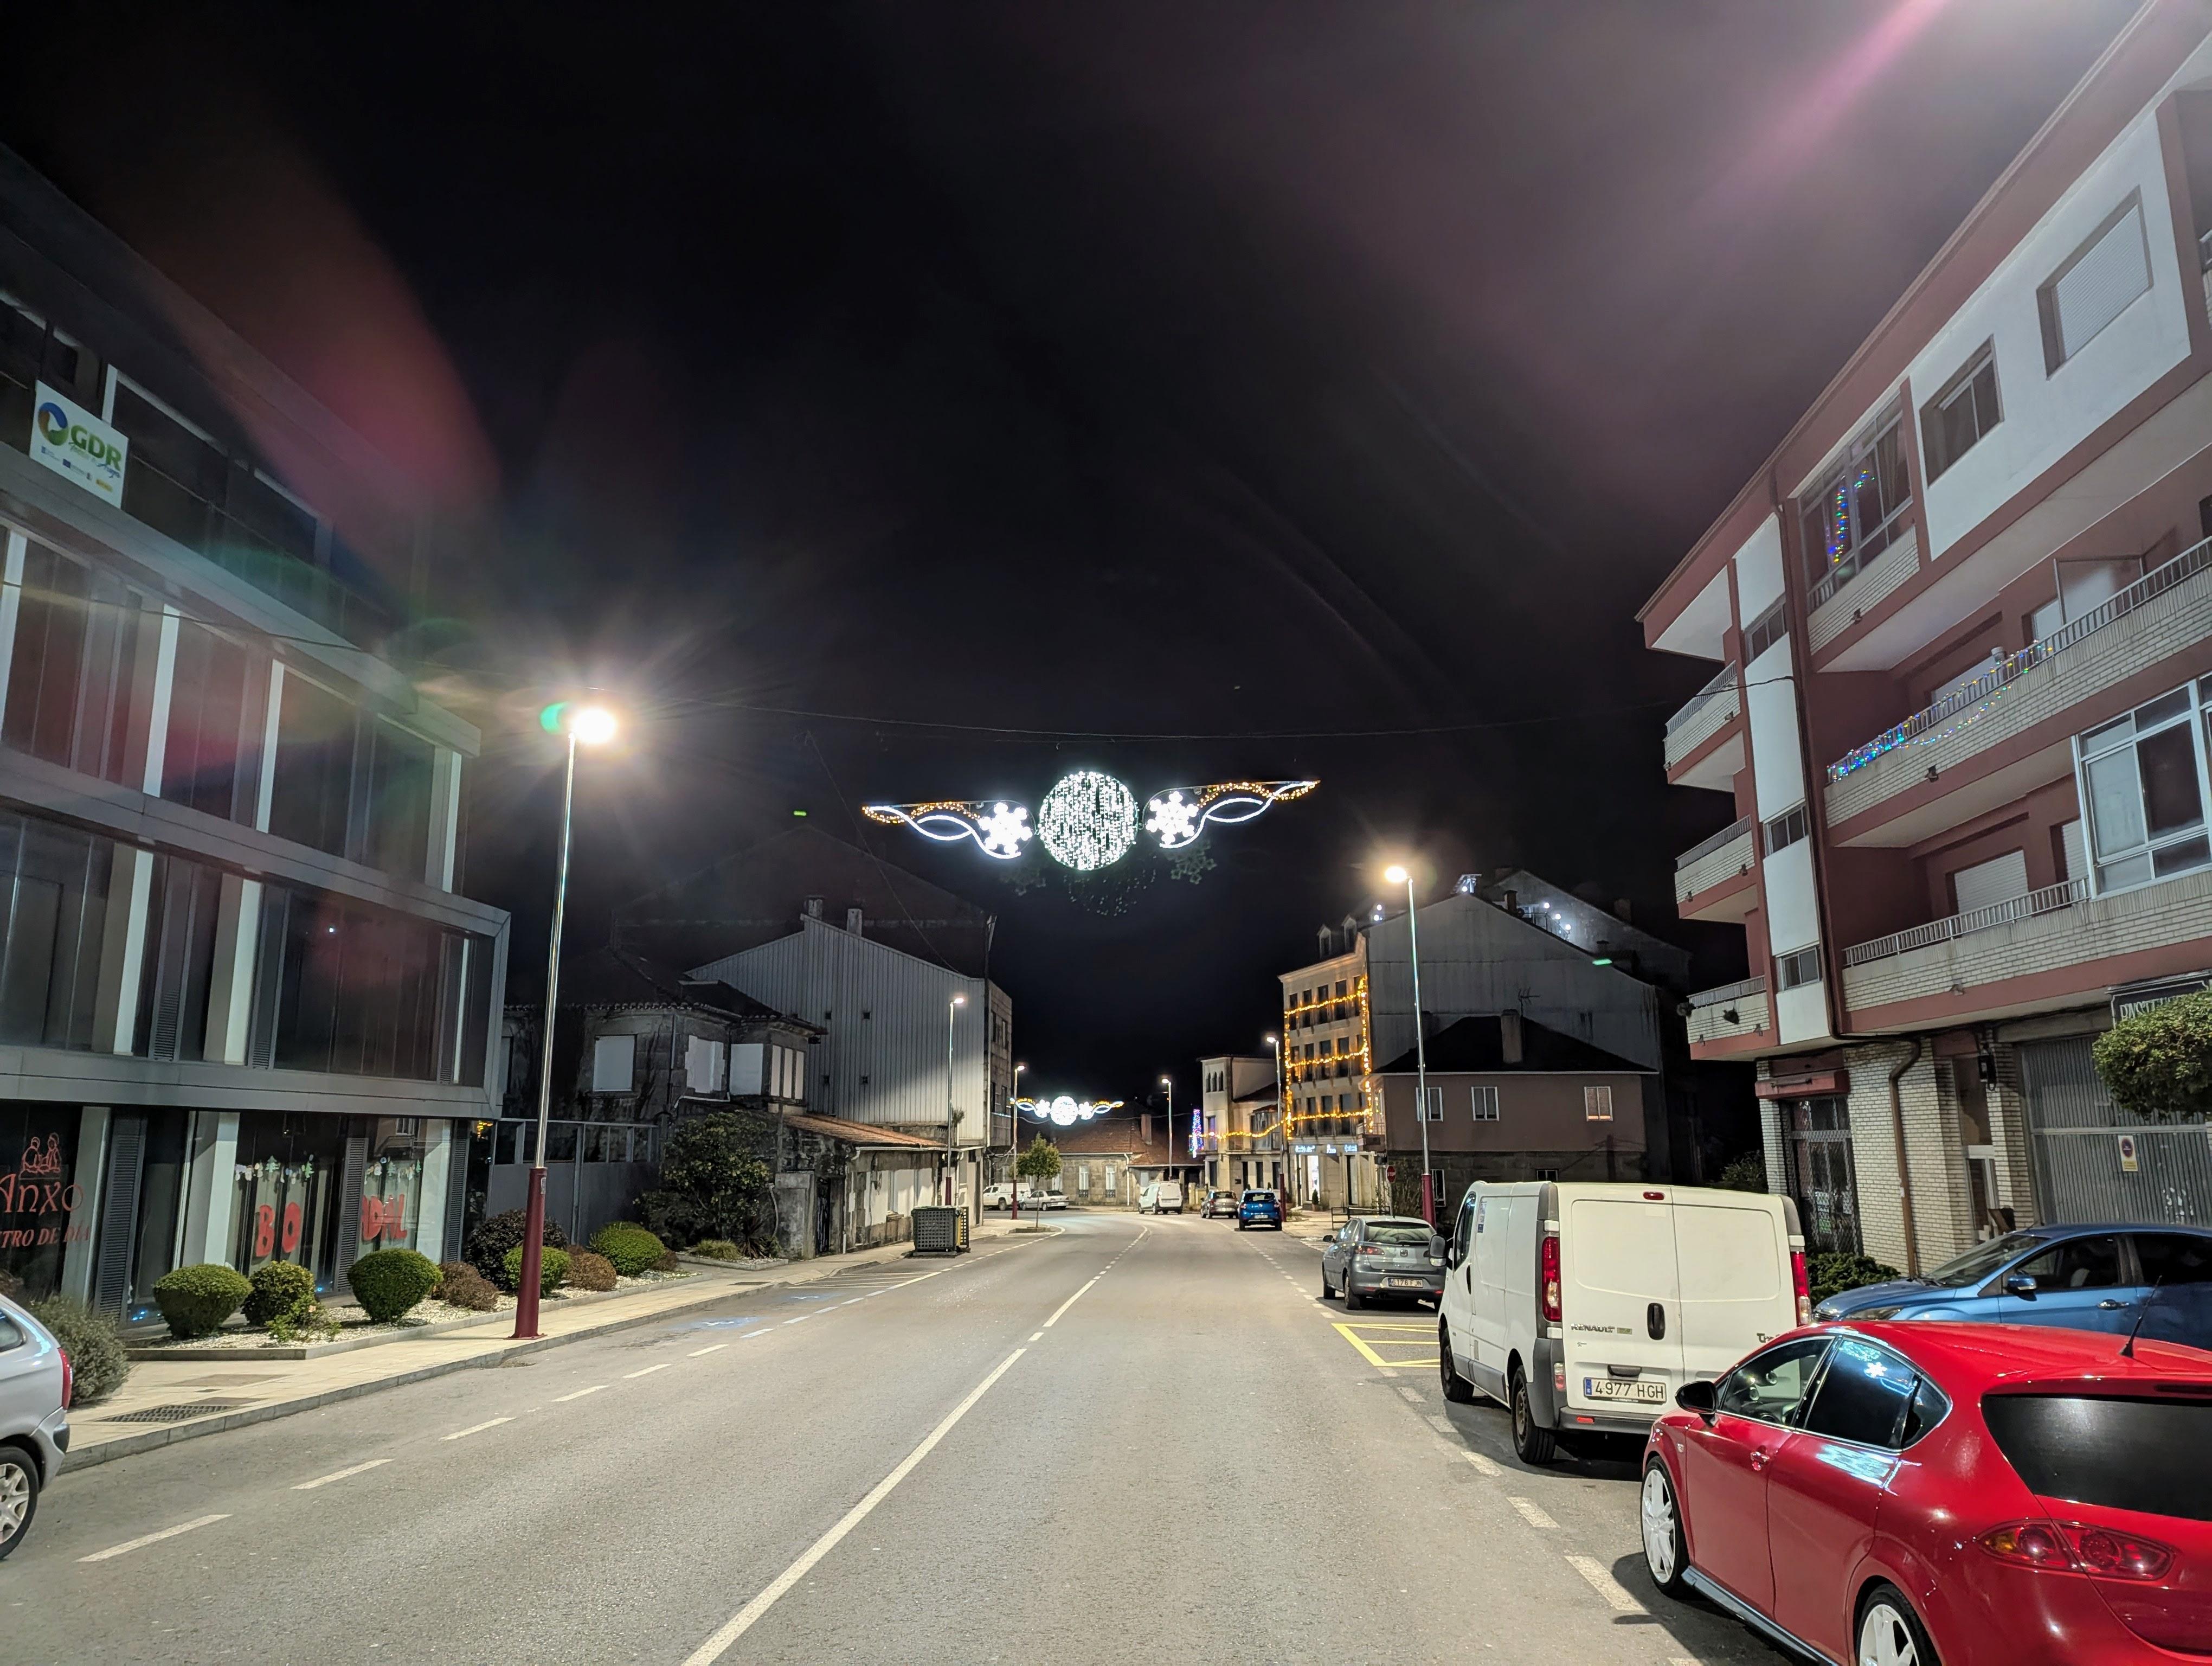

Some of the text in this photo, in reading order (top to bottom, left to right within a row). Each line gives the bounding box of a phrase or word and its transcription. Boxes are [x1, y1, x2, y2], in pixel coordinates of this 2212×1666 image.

[71, 425, 121, 471] GDR
[0, 1229, 35, 1248] TRO
[37, 1227, 61, 1245] DE
[1571, 1324, 1615, 1333] RENAULT
[1595, 1381, 1663, 1399] 4977 HGH
